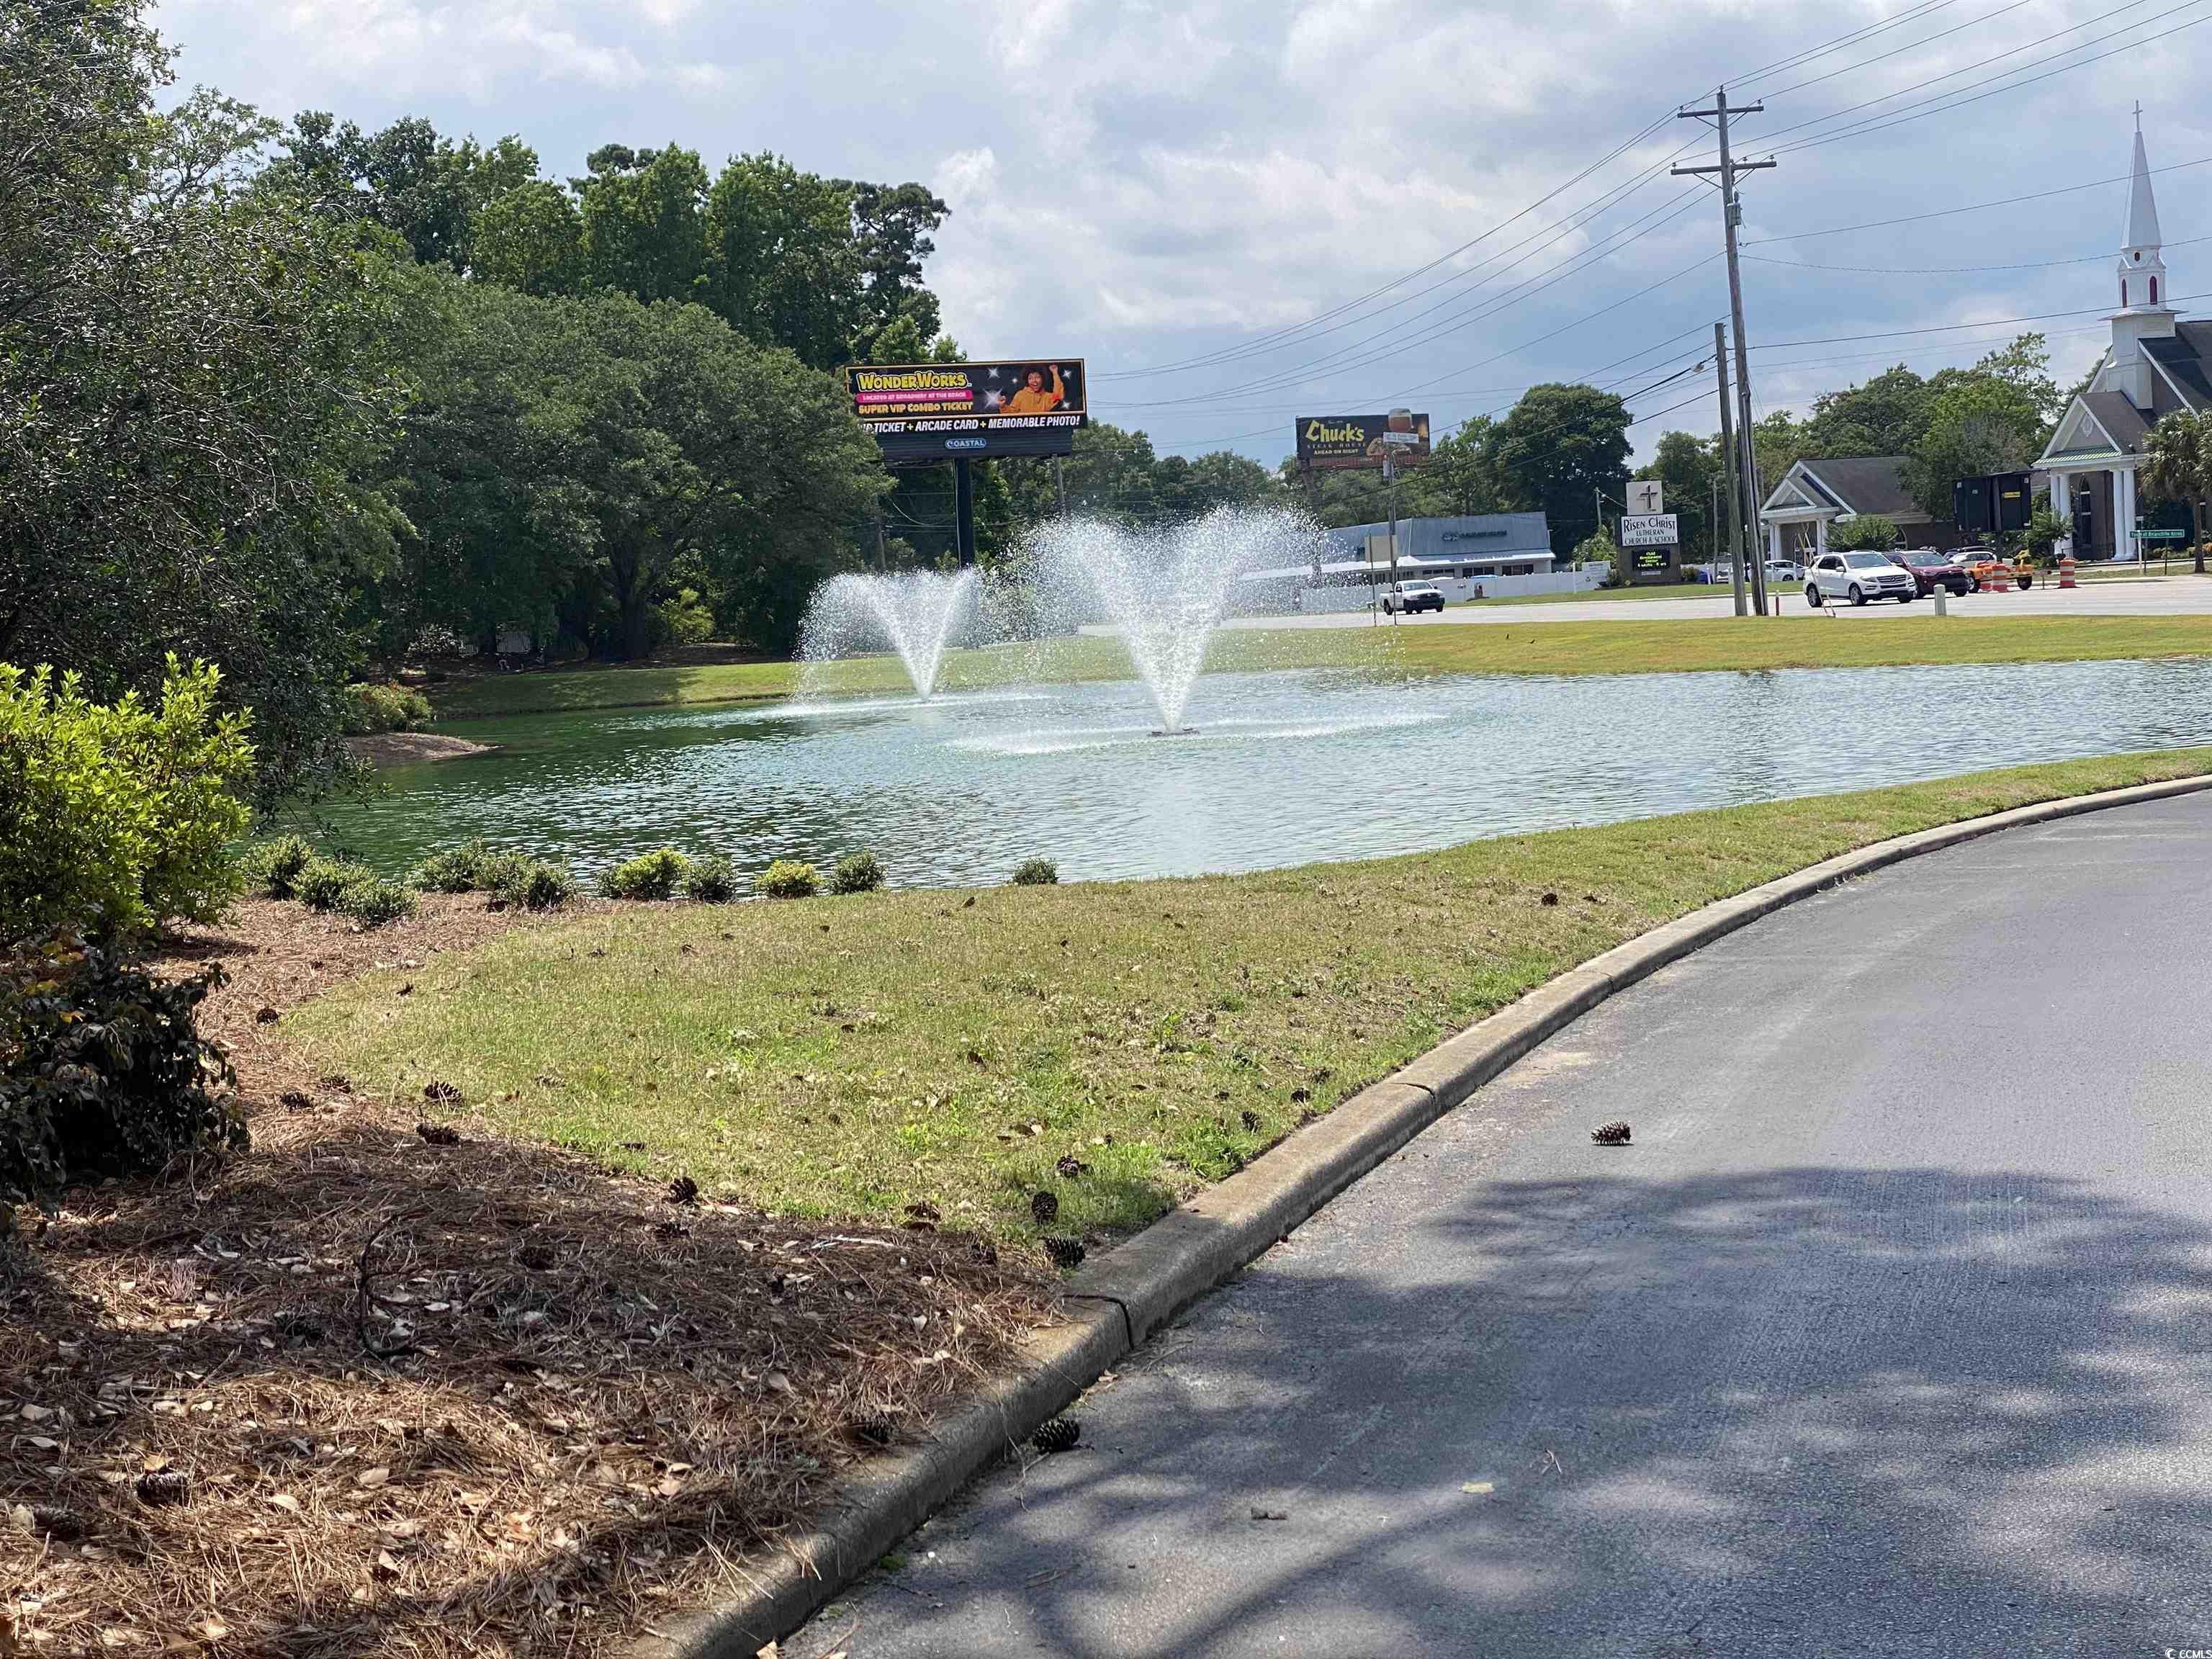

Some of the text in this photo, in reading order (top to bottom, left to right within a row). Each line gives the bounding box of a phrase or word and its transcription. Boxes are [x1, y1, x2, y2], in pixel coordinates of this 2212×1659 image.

[857, 371, 968, 391] WONDERWORKS
[858, 402, 973, 414] SUPER VIP COMBO TICKET
[874, 422, 907, 432] TICKET
[915, 421, 953, 431] ARCADE
[953, 420, 979, 431] CARD
[988, 417, 1045, 429] MEMORABLE
[1046, 415, 1081, 426] PHOTO!
[1305, 420, 1365, 443] Chuck's
